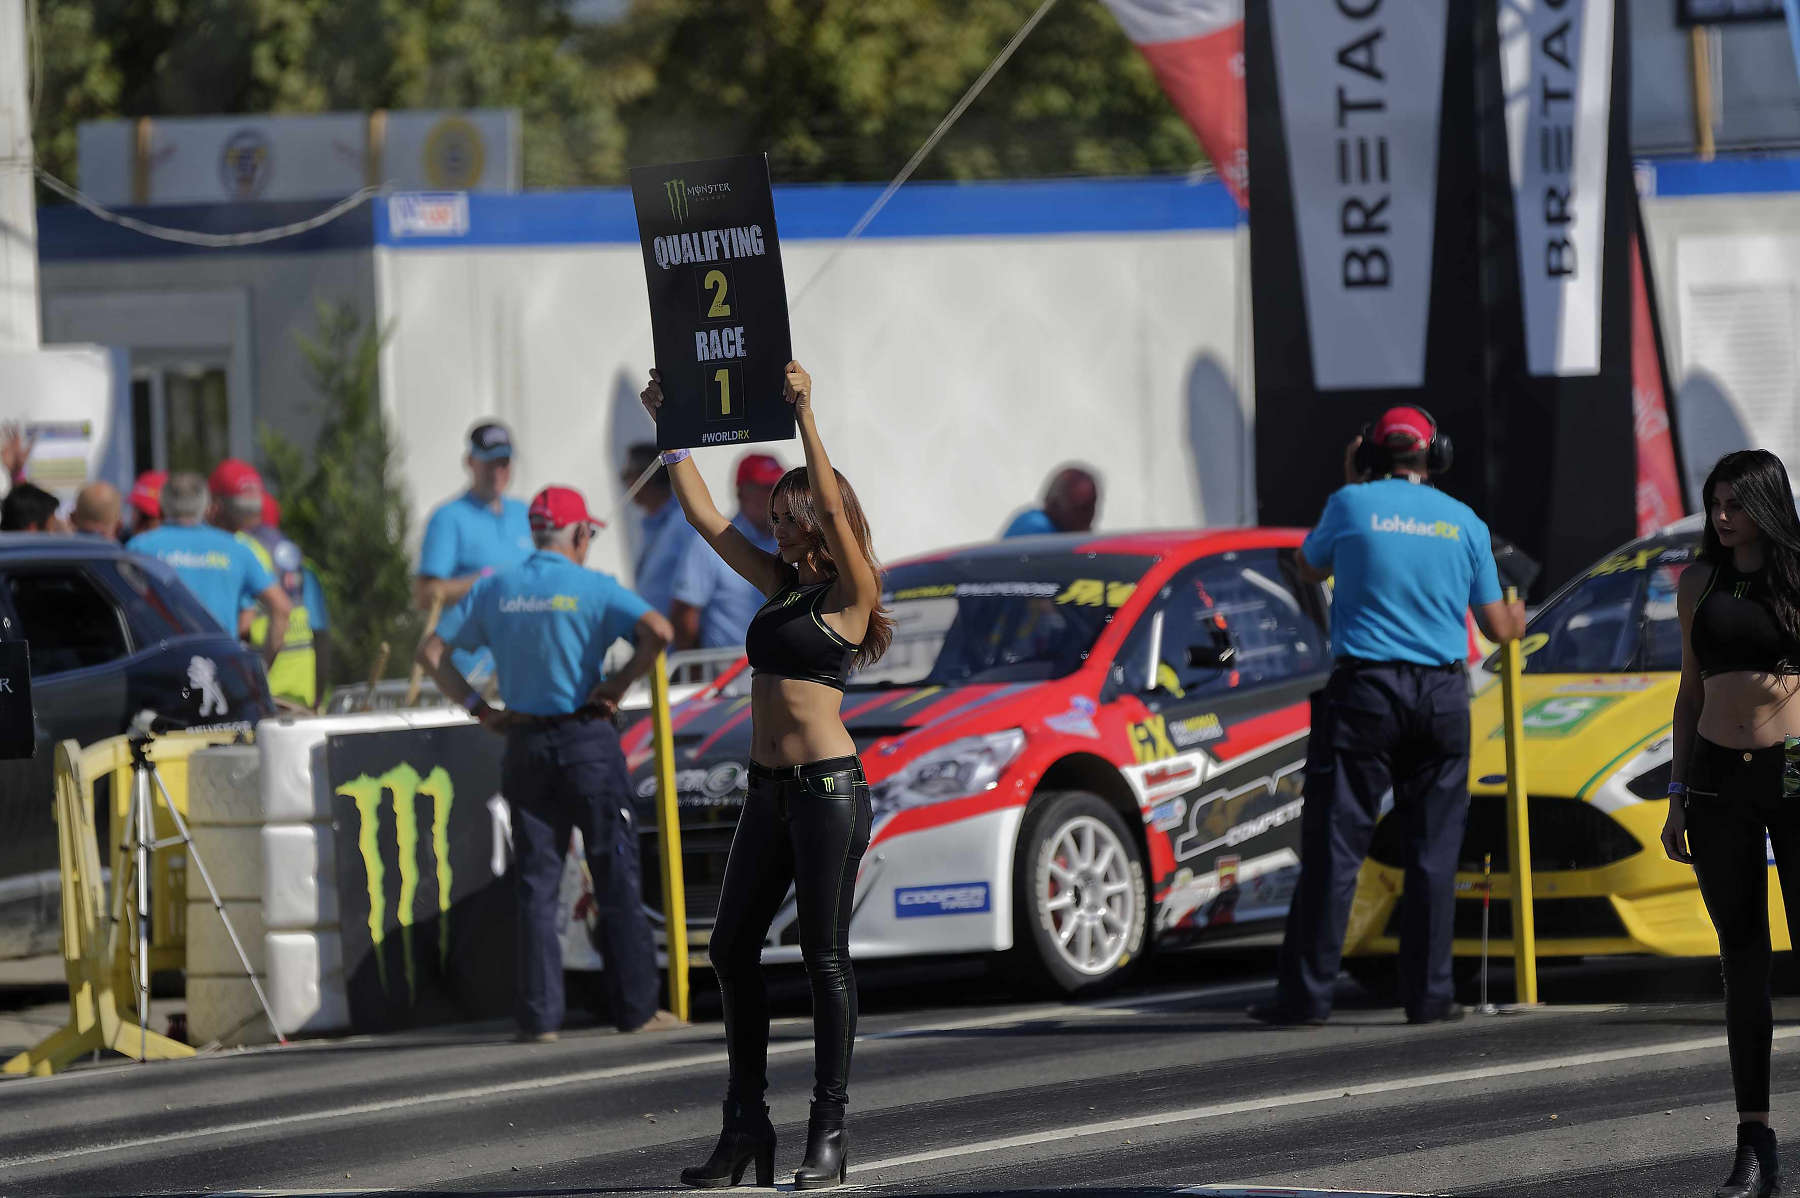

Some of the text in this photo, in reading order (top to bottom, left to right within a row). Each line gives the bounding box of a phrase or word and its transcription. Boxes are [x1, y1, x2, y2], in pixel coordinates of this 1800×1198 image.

[1541, 0, 1578, 279] BRETA
[687, 182, 732, 197] MONSTER
[653, 224, 766, 270] QUALIFYING
[704, 269, 731, 318] 2
[695, 326, 747, 362] RACE
[714, 368, 731, 415] 1
[702, 429, 750, 443] #WORLDRX
